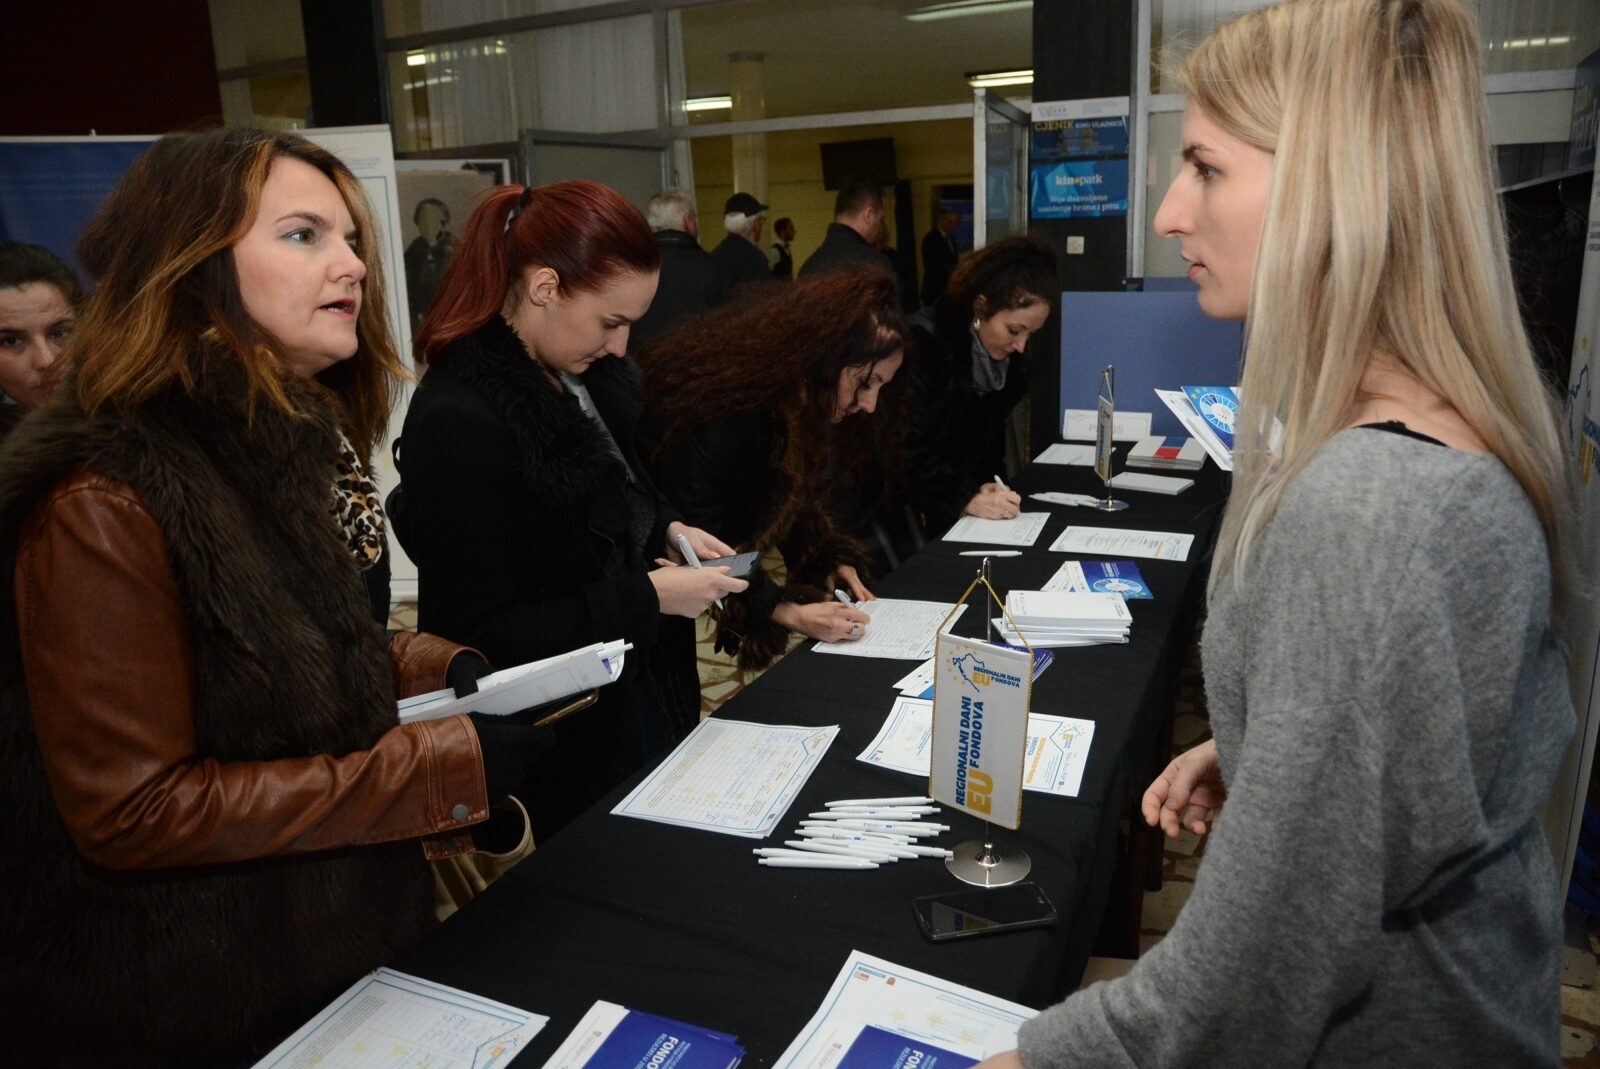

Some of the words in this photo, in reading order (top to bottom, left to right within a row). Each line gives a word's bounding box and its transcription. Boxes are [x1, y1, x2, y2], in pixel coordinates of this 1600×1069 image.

[972, 671, 992, 686] EU
[991, 676, 1020, 688] FONDOVA
[974, 666, 1006, 679] REGIONALNI
[1007, 674, 1021, 683] DANI
[960, 696, 972, 728] DANI
[969, 701, 984, 769] FONDOVA
[955, 730, 971, 806] REGIONALNI
[966, 768, 994, 816] EU
